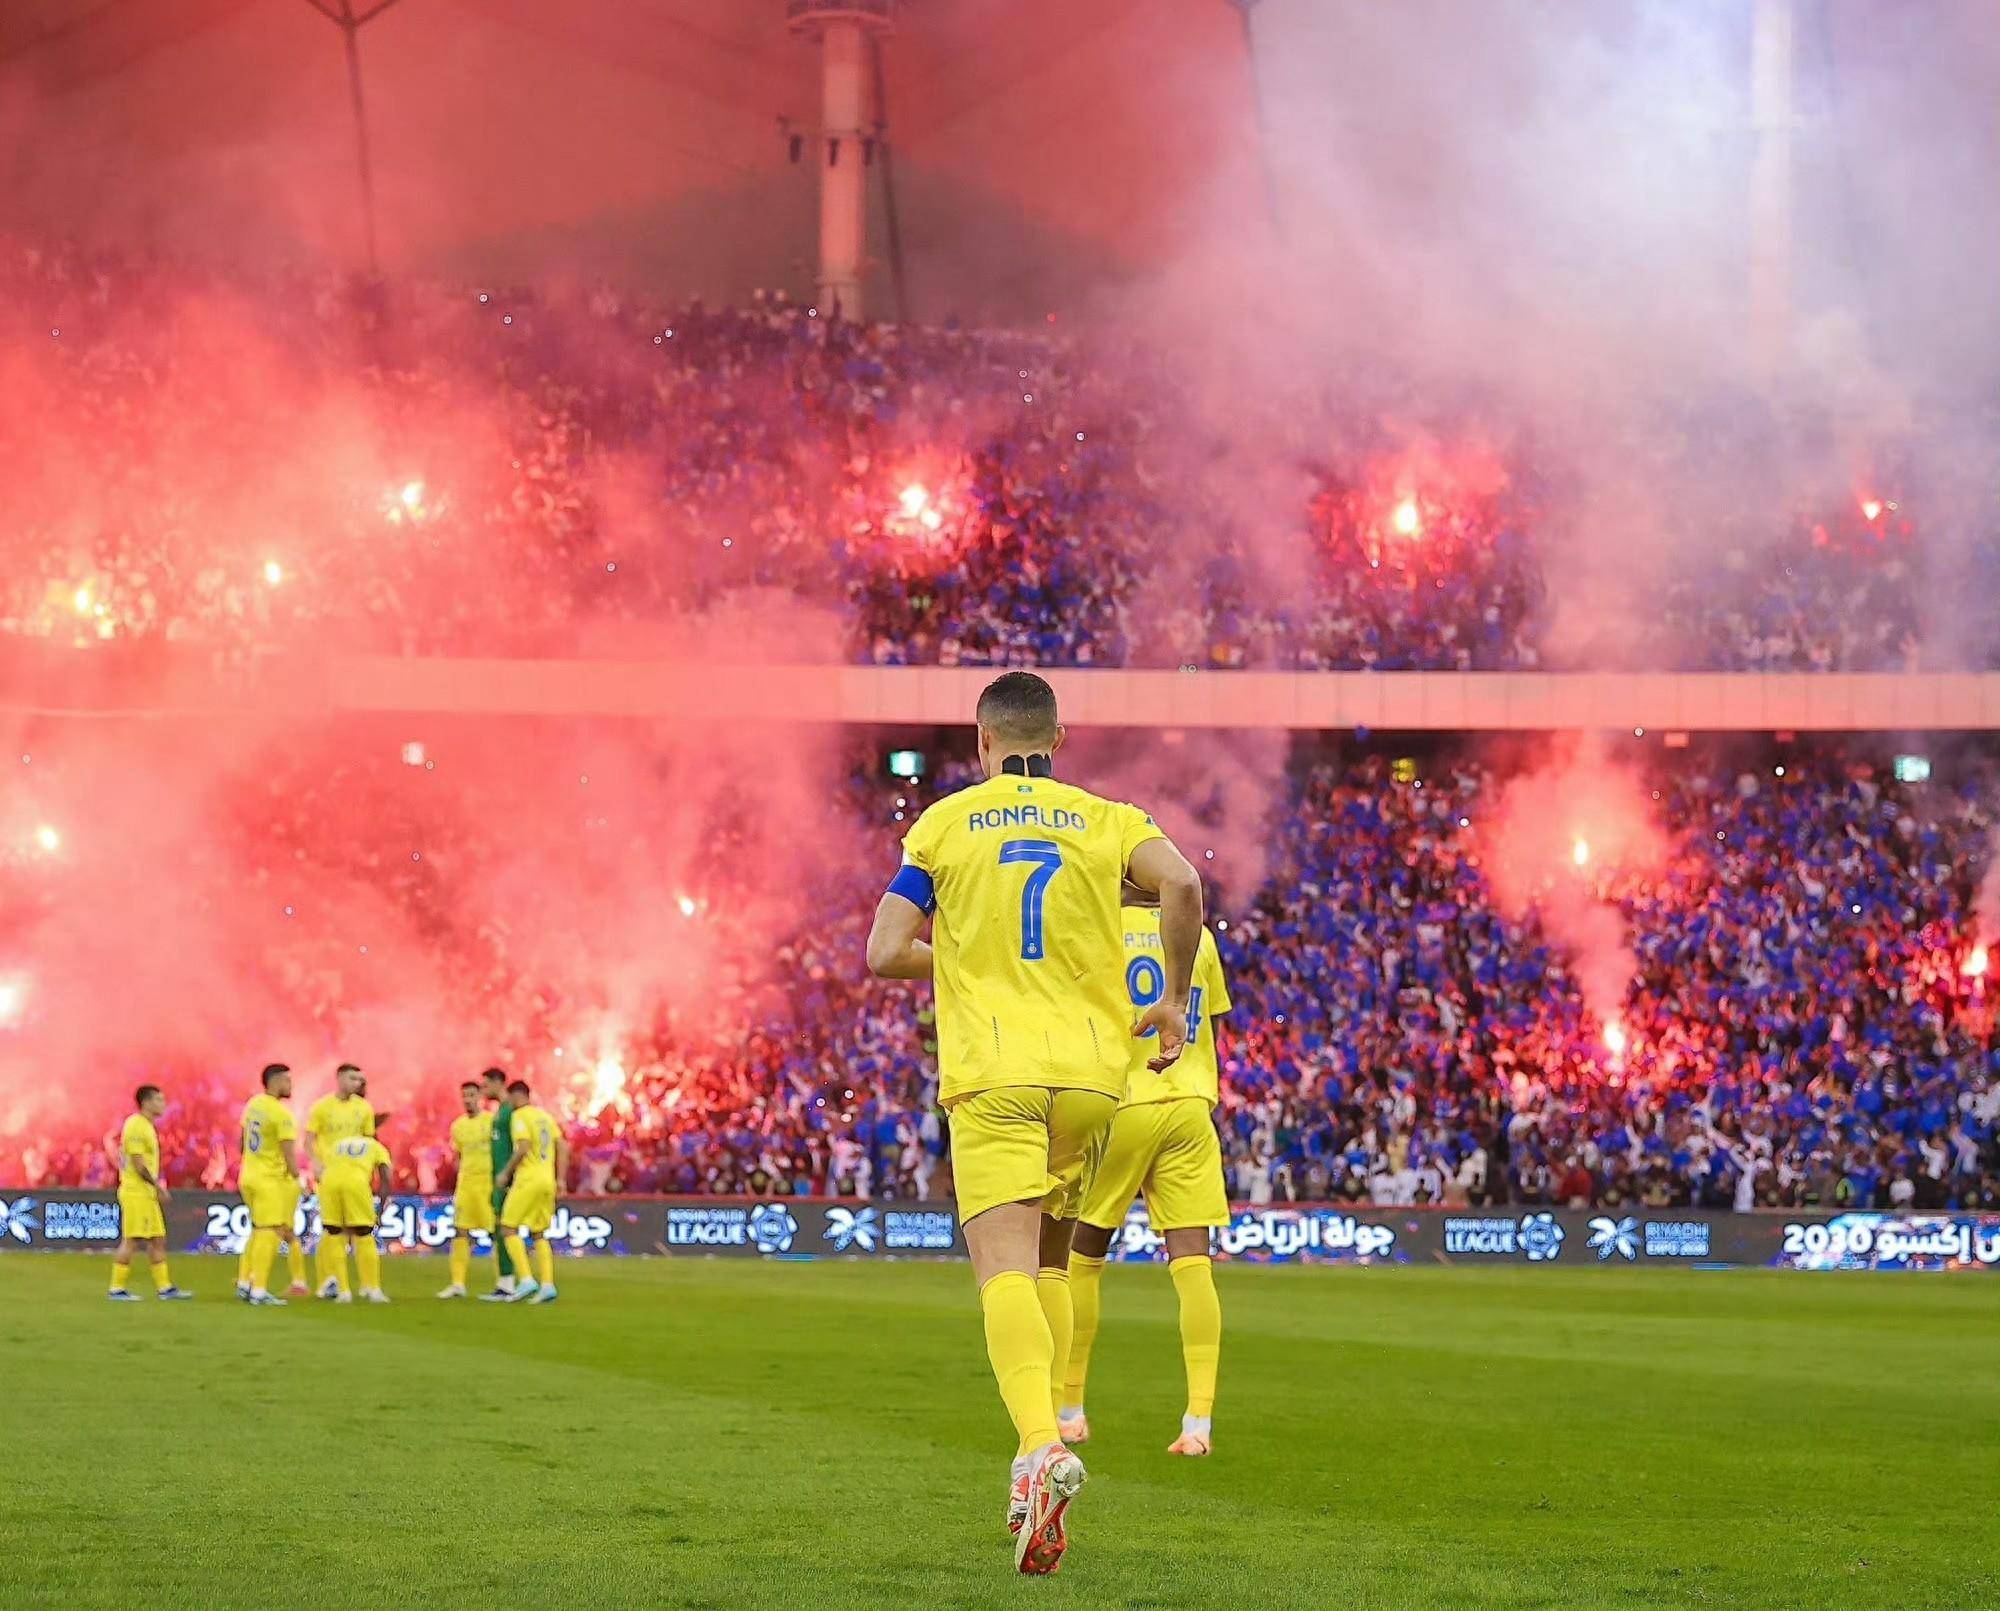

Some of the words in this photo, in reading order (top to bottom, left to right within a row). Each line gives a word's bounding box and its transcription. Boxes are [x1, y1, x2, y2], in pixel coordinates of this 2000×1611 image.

[969, 805, 1087, 832] RONALDO
[998, 839, 1063, 960] 7
[667, 1222, 747, 1244] LEAGUE
[1221, 1211, 1320, 1255] الرياض
[1323, 1215, 1396, 1256] جولة
[1783, 1223, 1873, 1253] 2030
[1876, 1222, 1972, 1265] إكسبو
